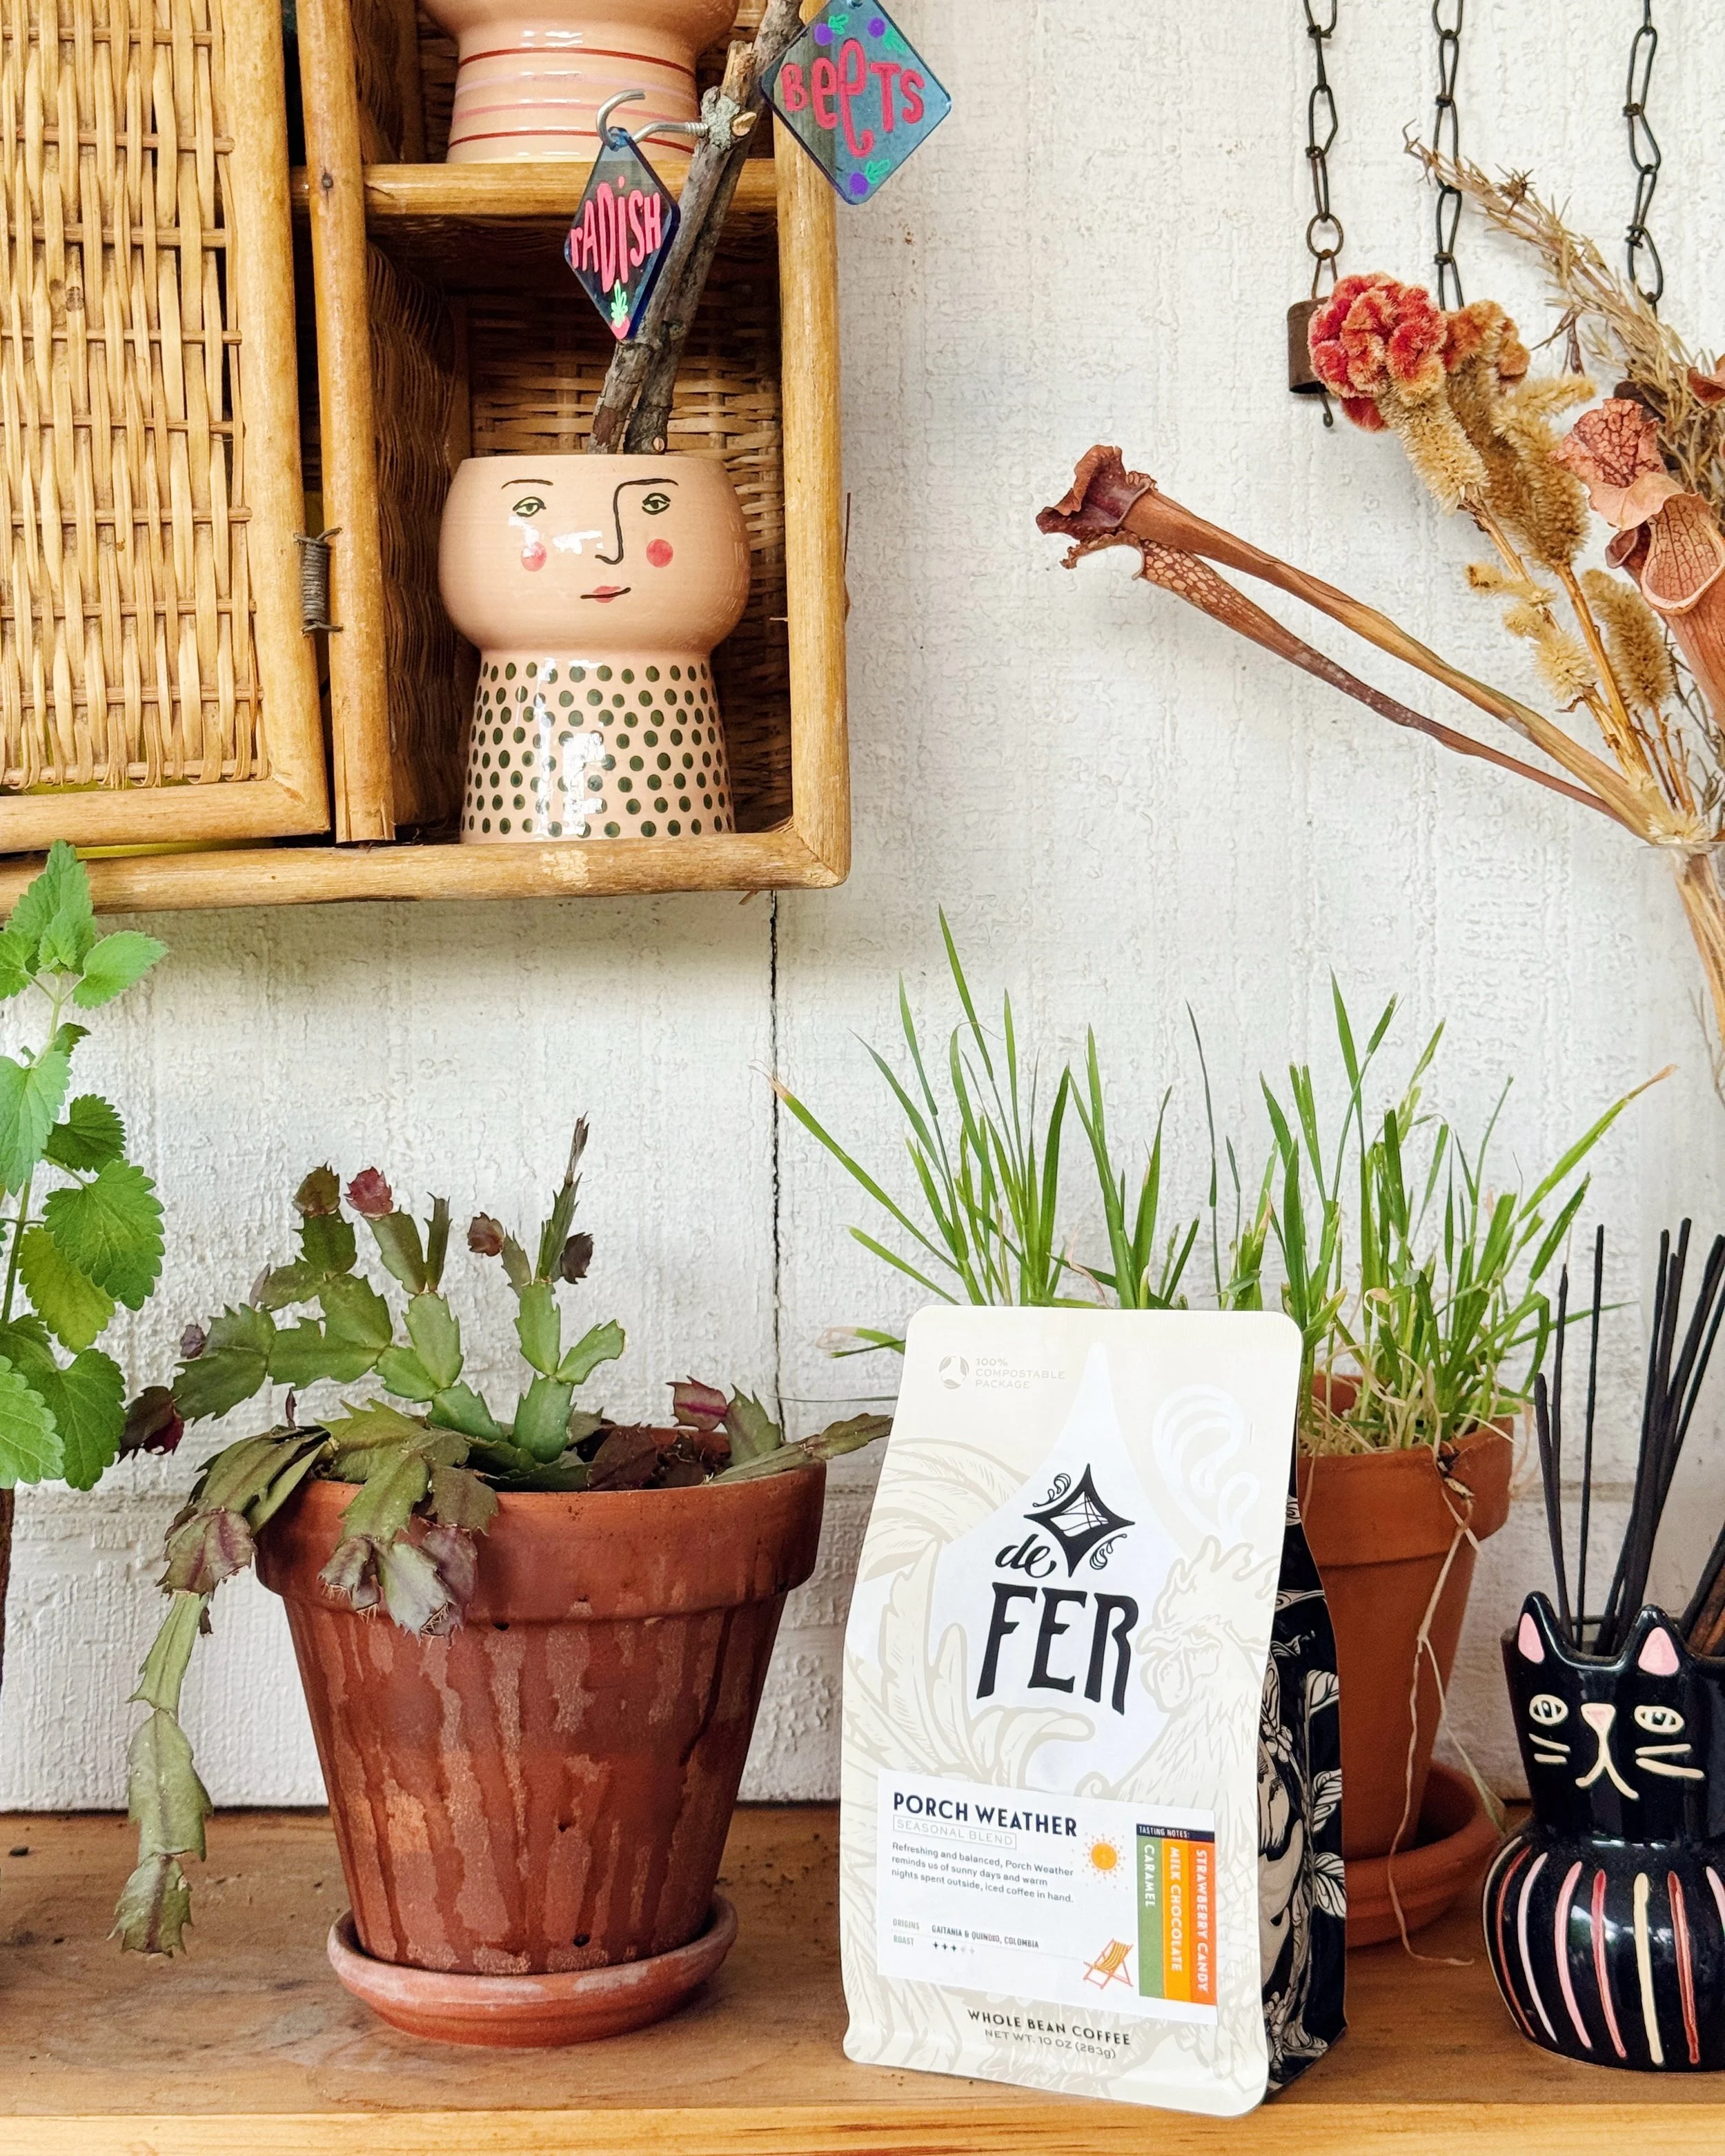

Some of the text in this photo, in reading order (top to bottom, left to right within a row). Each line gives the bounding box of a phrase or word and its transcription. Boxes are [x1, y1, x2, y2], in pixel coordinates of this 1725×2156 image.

[976, 1358, 1008, 1367] 100%
[976, 1368, 1066, 1379] COMPOSTABLE
[975, 1380, 1029, 1389] PACKAGE
[994, 1533, 1057, 1578] de
[976, 1582, 1139, 1715] FER
[894, 1791, 1077, 1837] PORCH WEATHER
[897, 1819, 1013, 1845] SEASONAL BLEND
[1138, 1826, 1190, 1839] TASTING NOTES:
[891, 1856, 926, 1868] reminds
[940, 1863, 949, 1871] of
[951, 1866, 978, 1877] sunny
[979, 1869, 1001, 1880] days
[1003, 1874, 1020, 1882] and
[1022, 1877, 1048, 1886] warm
[892, 1841, 1074, 1876] Refreshing and balanced, Porch Weather
[891, 1868, 1074, 1903] nights spent outside, iced coffee in hand.
[1144, 1844, 1156, 1908] CARAMEL
[1170, 1846, 1183, 1972] MILK CHOCOLATE
[1196, 1849, 1210, 1994] STRAWBERRY CANDY
[892, 1918, 920, 1930] ORIGINS
[931, 1924, 963, 1937] GAITANIA
[1004, 1936, 1039, 1948] COLOMBIA
[893, 1935, 914, 1946] ROAST
[967, 2008, 1131, 2045] WHOLE BEAN COFFEE
[985, 2028, 1116, 2059] NET WT. 10 OZ (283g)
